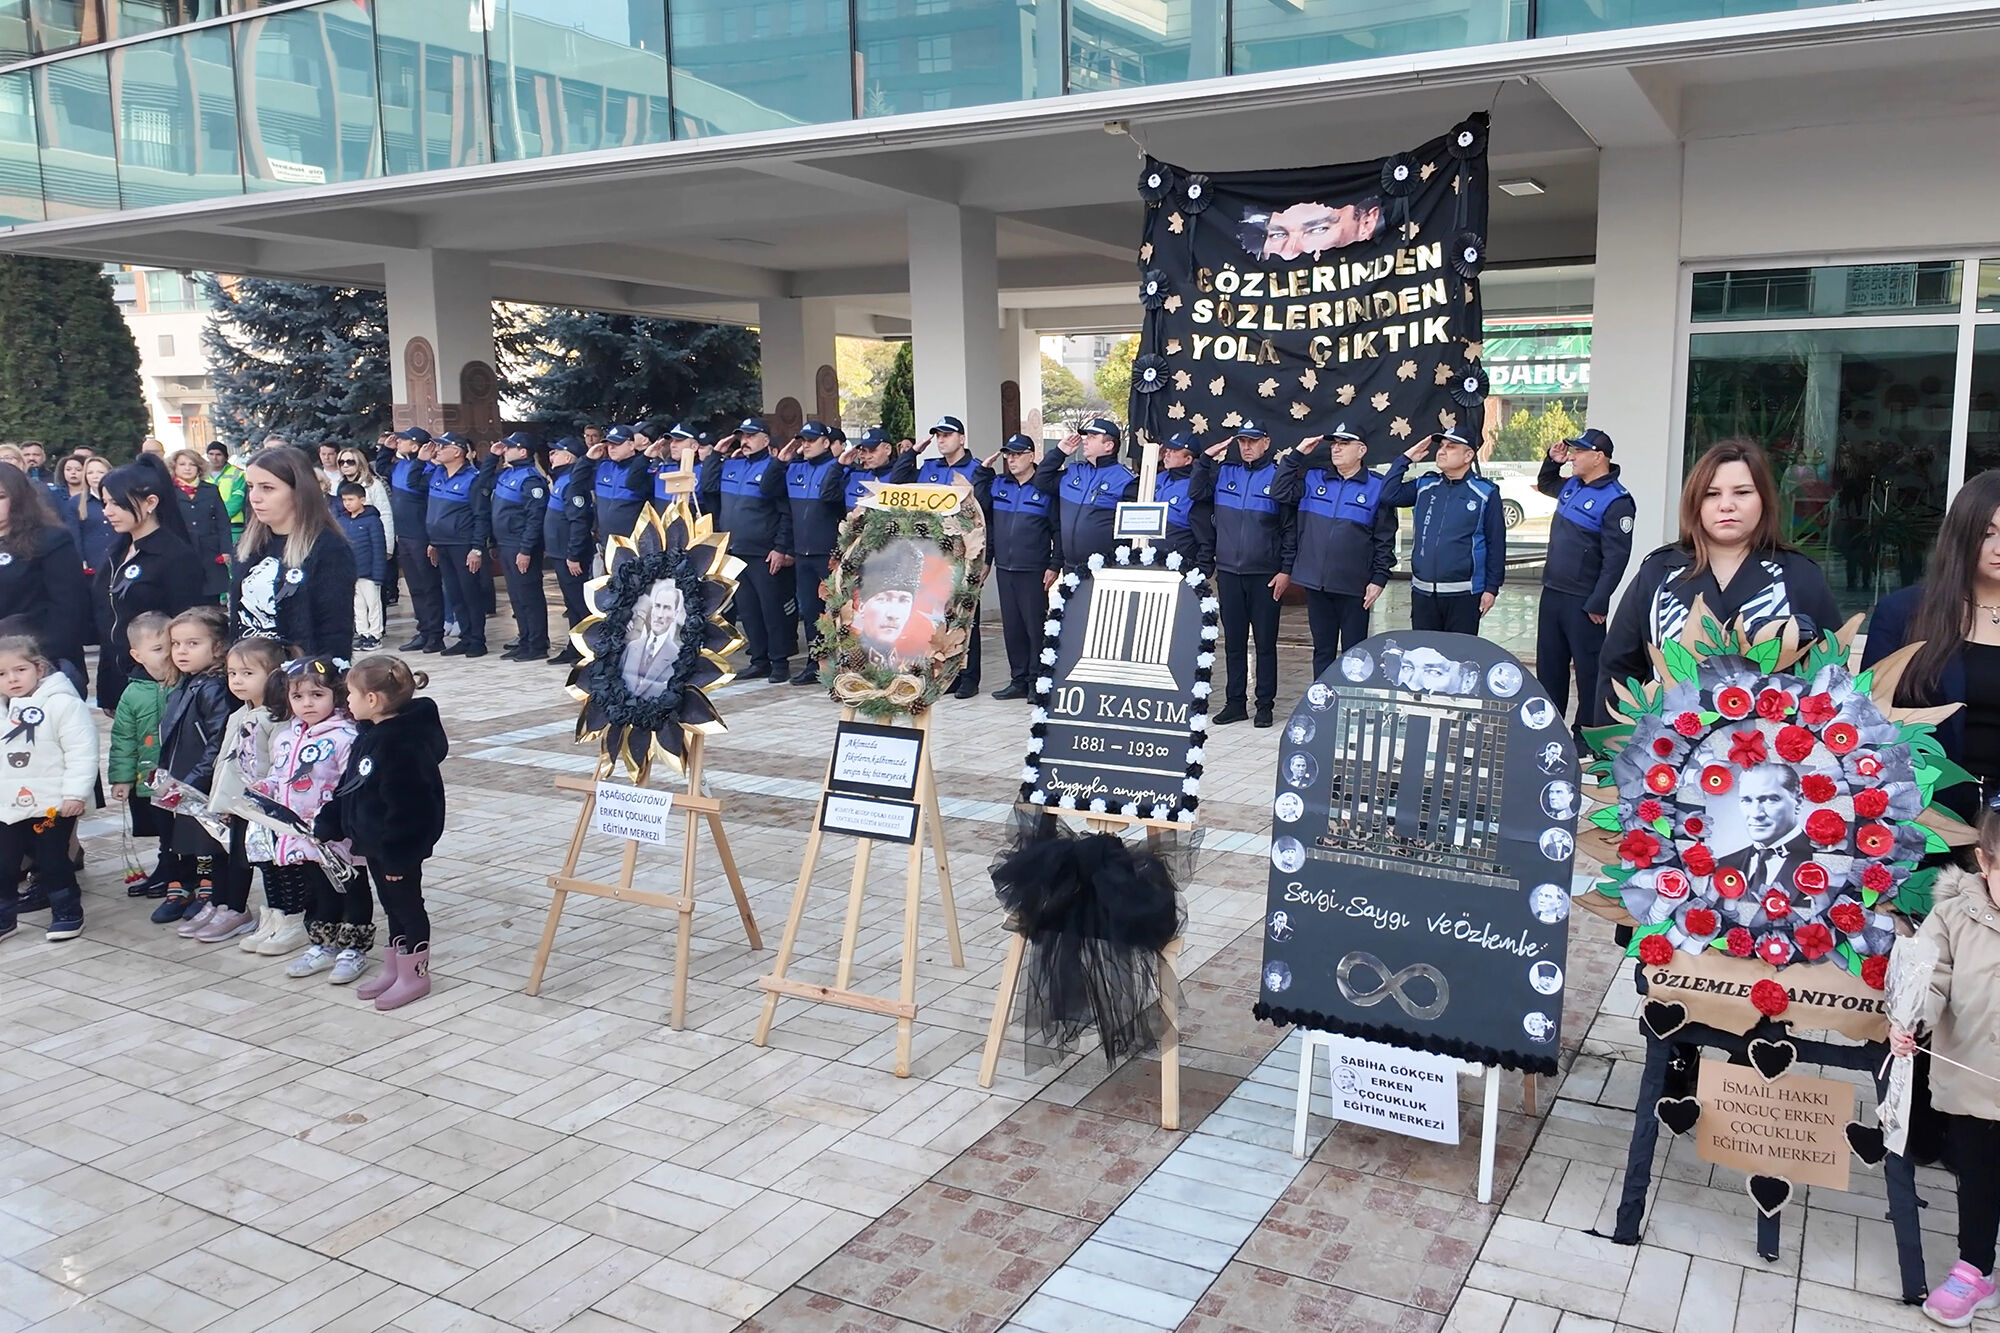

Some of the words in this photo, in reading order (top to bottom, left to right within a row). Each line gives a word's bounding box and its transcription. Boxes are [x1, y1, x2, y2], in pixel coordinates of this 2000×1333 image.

[1196, 242, 1442, 298] GÖZLERİNDEN
[1191, 333, 1281, 365] YOLA
[1309, 316, 1451, 369] ÇIKTIK
[1420, 494, 1437, 557] ZABITA
[1054, 686, 1085, 716] 10
[1097, 694, 1189, 724] KASIM
[1072, 735, 1105, 752] 1881
[1046, 767, 1109, 799] Saygıyla
[599, 806, 624, 818] ERKEN
[625, 810, 662, 825] ÇOCUKLUK
[602, 822, 628, 836] EĞİTİM
[1345, 897, 1410, 930] Saygı
[1652, 968, 1752, 998] ÖZLEMLE
[1785, 987, 1886, 1014] ANIYORU
[1341, 1055, 1386, 1072] SABİHA
[1390, 1065, 1444, 1083] GÖKÇEN
[1371, 1077, 1413, 1093] ERKEN
[1722, 1078, 1774, 1099] İSMAİL
[1779, 1088, 1828, 1105] HAKKI
[1358, 1089, 1427, 1111] ÇOCUKLUK
[1714, 1098, 1781, 1121] TONGUÇ
[1785, 1109, 1836, 1126] ERKEN
[1343, 1100, 1385, 1117] EĞİTİM
[1389, 1110, 1445, 1130] MERKEZİ
[1730, 1120, 1817, 1143] ÇOCUKLUK
[1712, 1135, 1763, 1155] EĞİTİM
[1768, 1145, 1837, 1165] MERKEZİ
